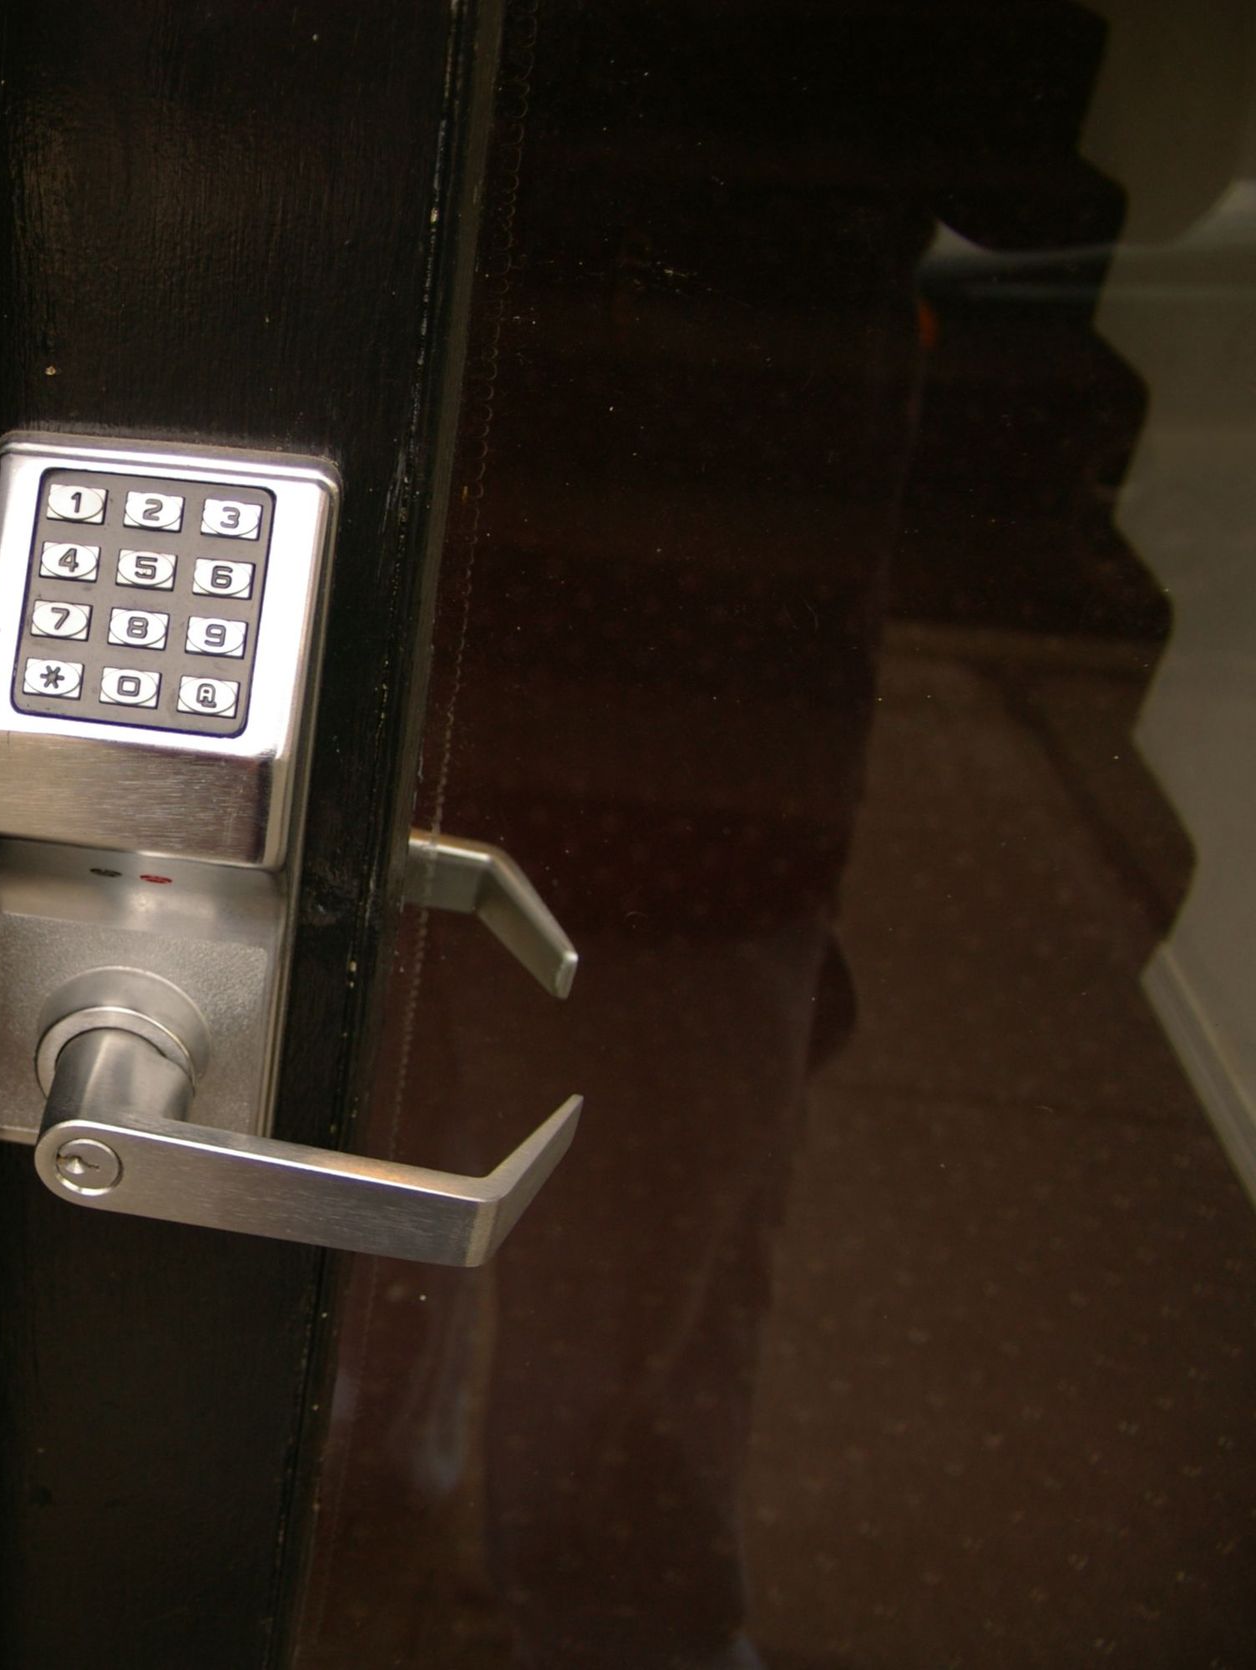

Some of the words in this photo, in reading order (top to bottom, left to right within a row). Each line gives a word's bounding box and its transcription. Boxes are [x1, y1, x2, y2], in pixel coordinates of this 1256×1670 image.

[70, 492, 83, 513] 1
[143, 498, 163, 521] 2
[219, 506, 241, 529] 3
[58, 547, 79, 572] 4
[134, 556, 158, 580] 5
[210, 565, 234, 589] 6
[50, 607, 71, 630] 7
[126, 616, 149, 639] 8
[204, 623, 227, 647] 9
[116, 675, 141, 697] 0
